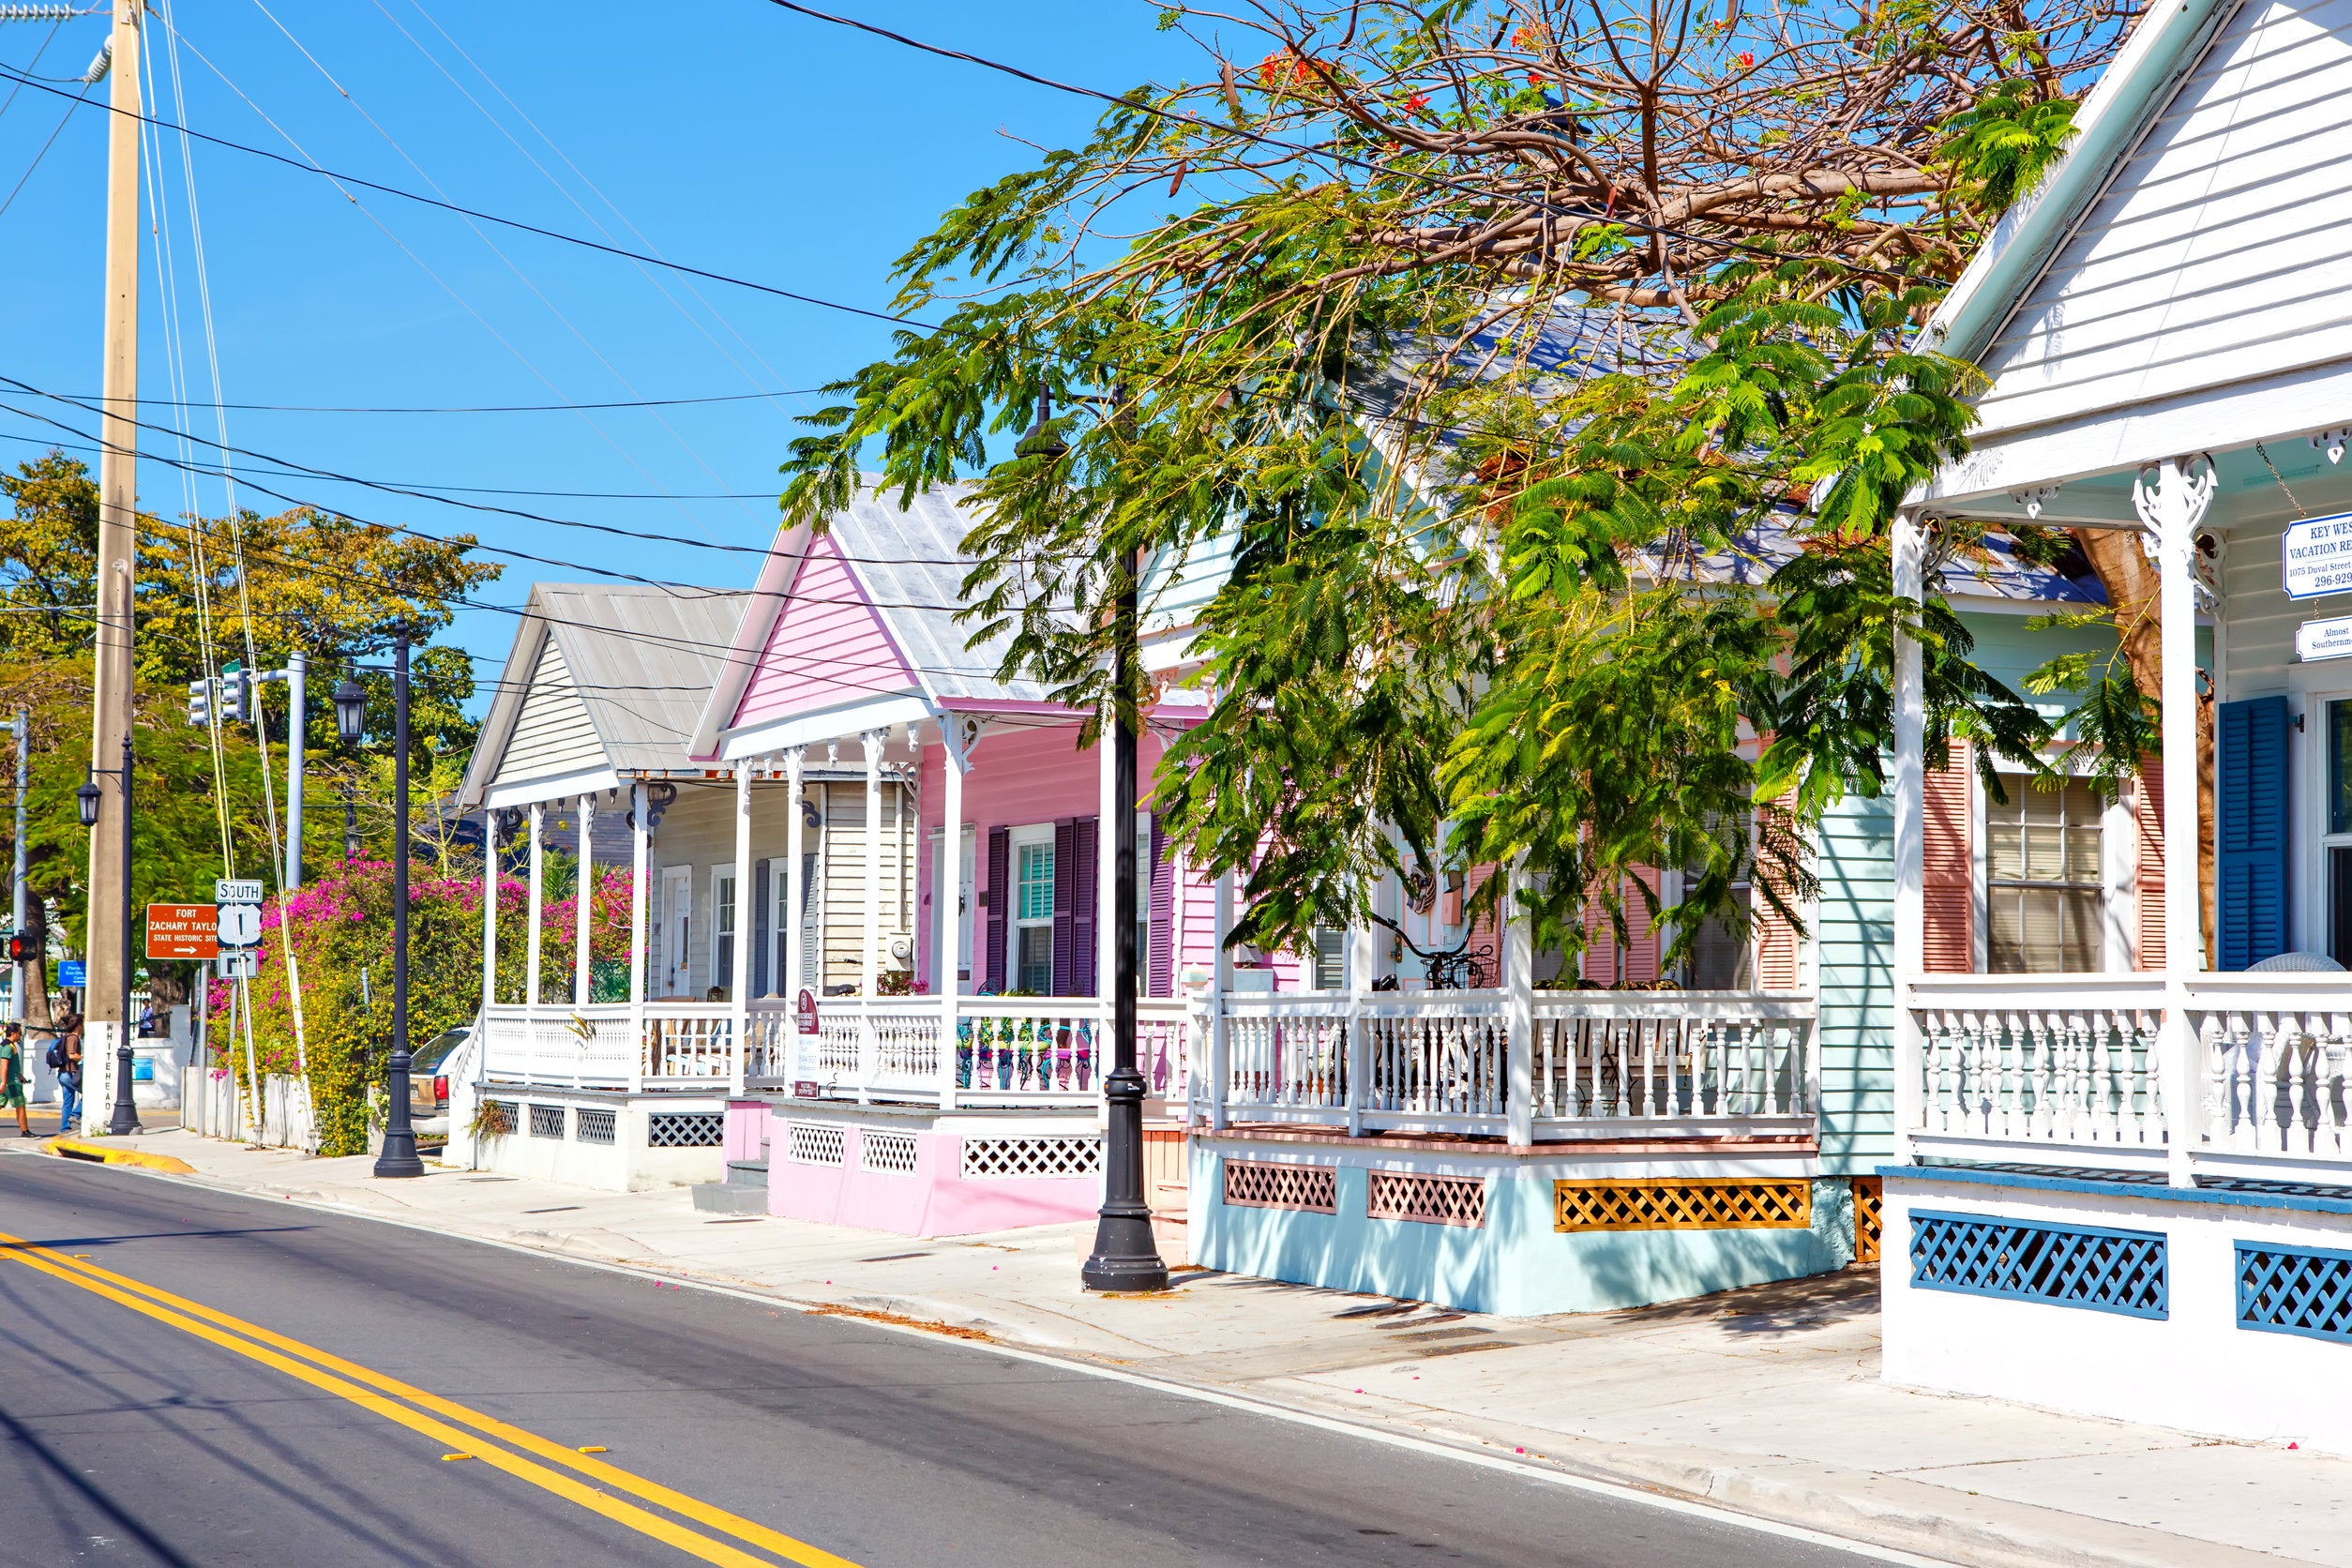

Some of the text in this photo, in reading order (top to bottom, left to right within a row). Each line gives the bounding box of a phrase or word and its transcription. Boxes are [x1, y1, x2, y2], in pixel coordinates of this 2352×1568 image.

[2310, 520, 2352, 539] KEY WES
[2289, 542, 2336, 559] VACATION
[2289, 566, 2306, 578] 1075
[2307, 564, 2328, 575] Duval
[2314, 571, 2352, 588] 296-929
[2323, 627, 2349, 638] Almost
[2311, 639, 2352, 650] Southernm
[219, 883, 259, 898] SOUTH
[175, 908, 197, 918] FORT
[149, 921, 218, 931] ZACHARY TAYLO
[238, 912, 243, 936] 1
[173, 934, 203, 942] HISTORIC
[105, 1023, 113, 1110] WHITEHEAD
